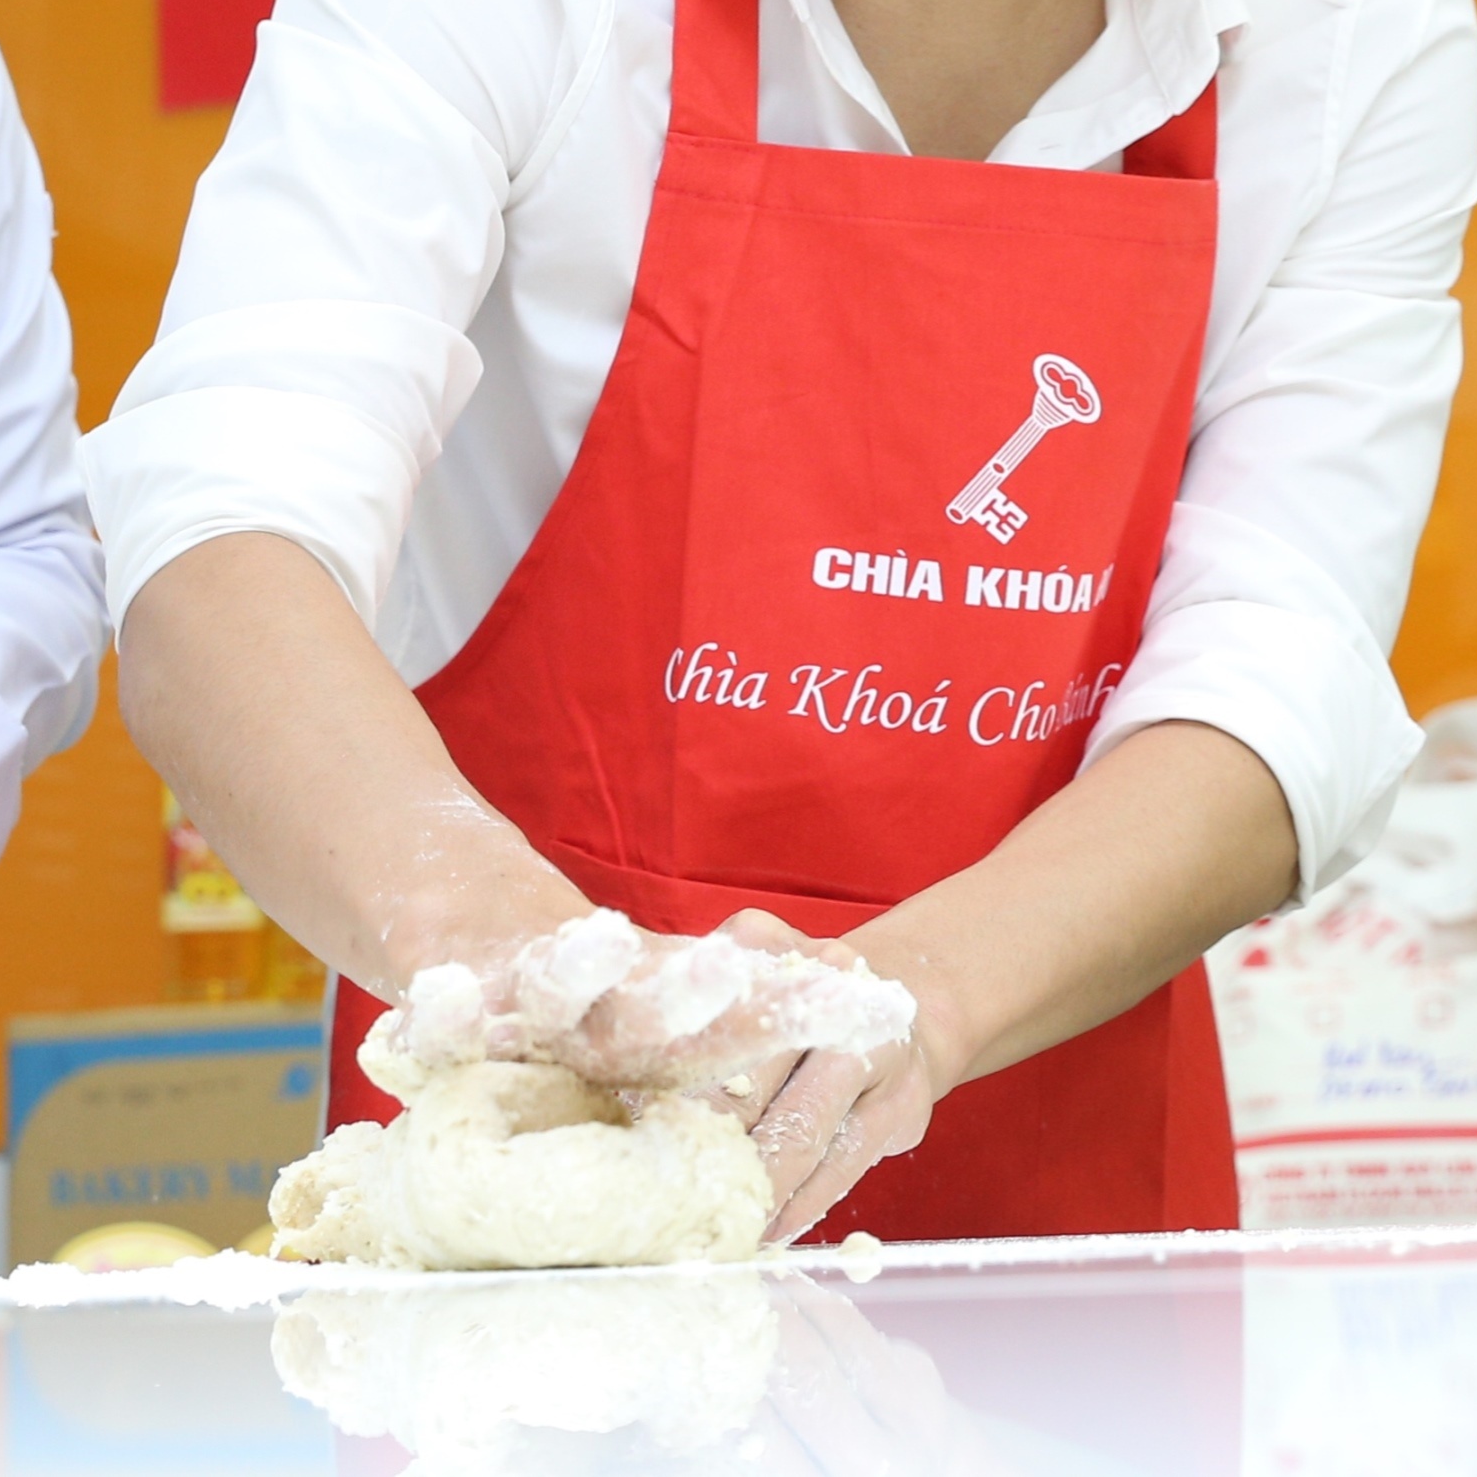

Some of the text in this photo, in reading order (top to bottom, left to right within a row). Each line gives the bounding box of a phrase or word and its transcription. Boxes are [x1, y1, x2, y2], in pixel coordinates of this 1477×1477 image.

[812, 546, 944, 602] CHÌA
[964, 564, 1093, 613] KHÓA
[787, 664, 951, 734] Khoá
[968, 680, 1057, 746] Cho
